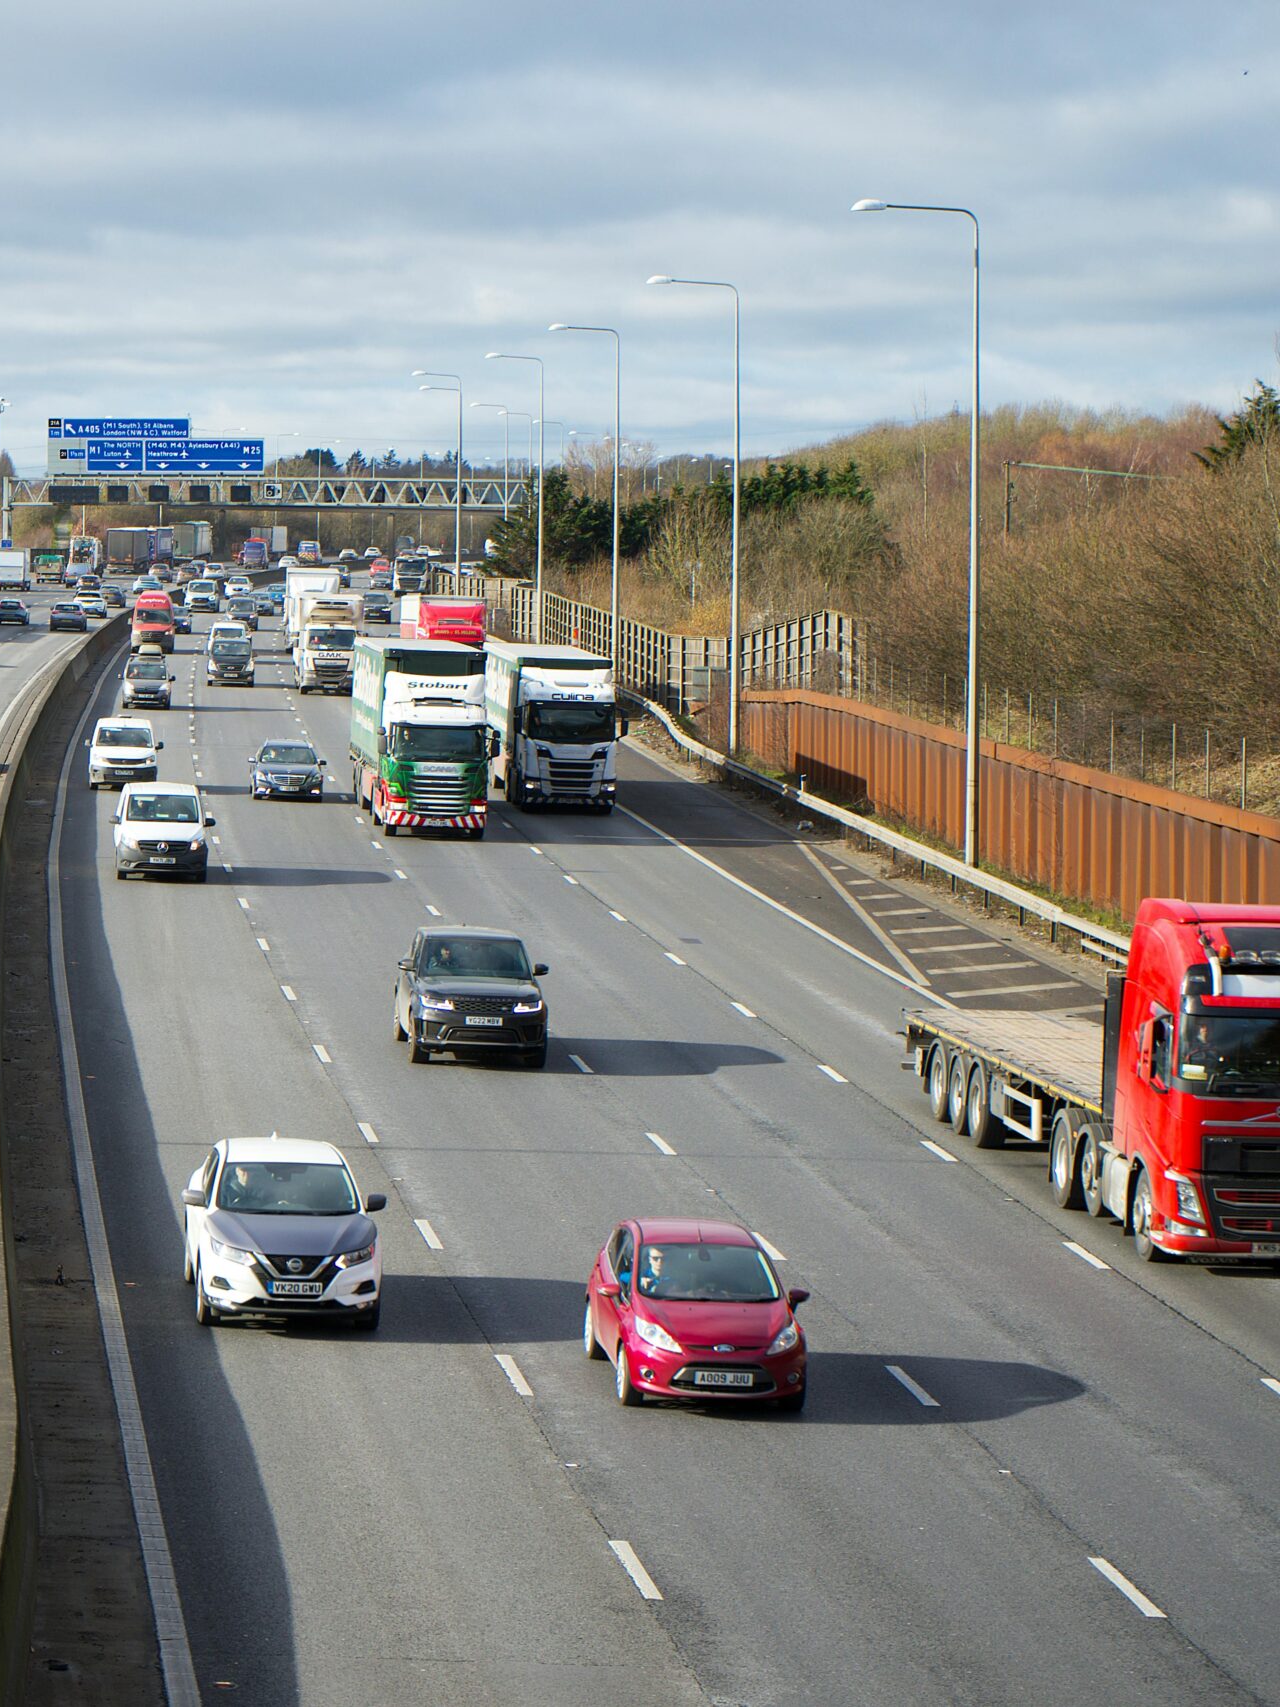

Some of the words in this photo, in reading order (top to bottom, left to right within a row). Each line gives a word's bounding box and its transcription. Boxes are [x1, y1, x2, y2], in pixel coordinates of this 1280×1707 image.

[188, 442, 219, 450] Aylesbury
[408, 681, 468, 690] Stobart
[552, 693, 594, 701] culina
[275, 1283, 300, 1293] VK20
[302, 1284, 321, 1294] GWU
[729, 1375, 750, 1384] JUU
